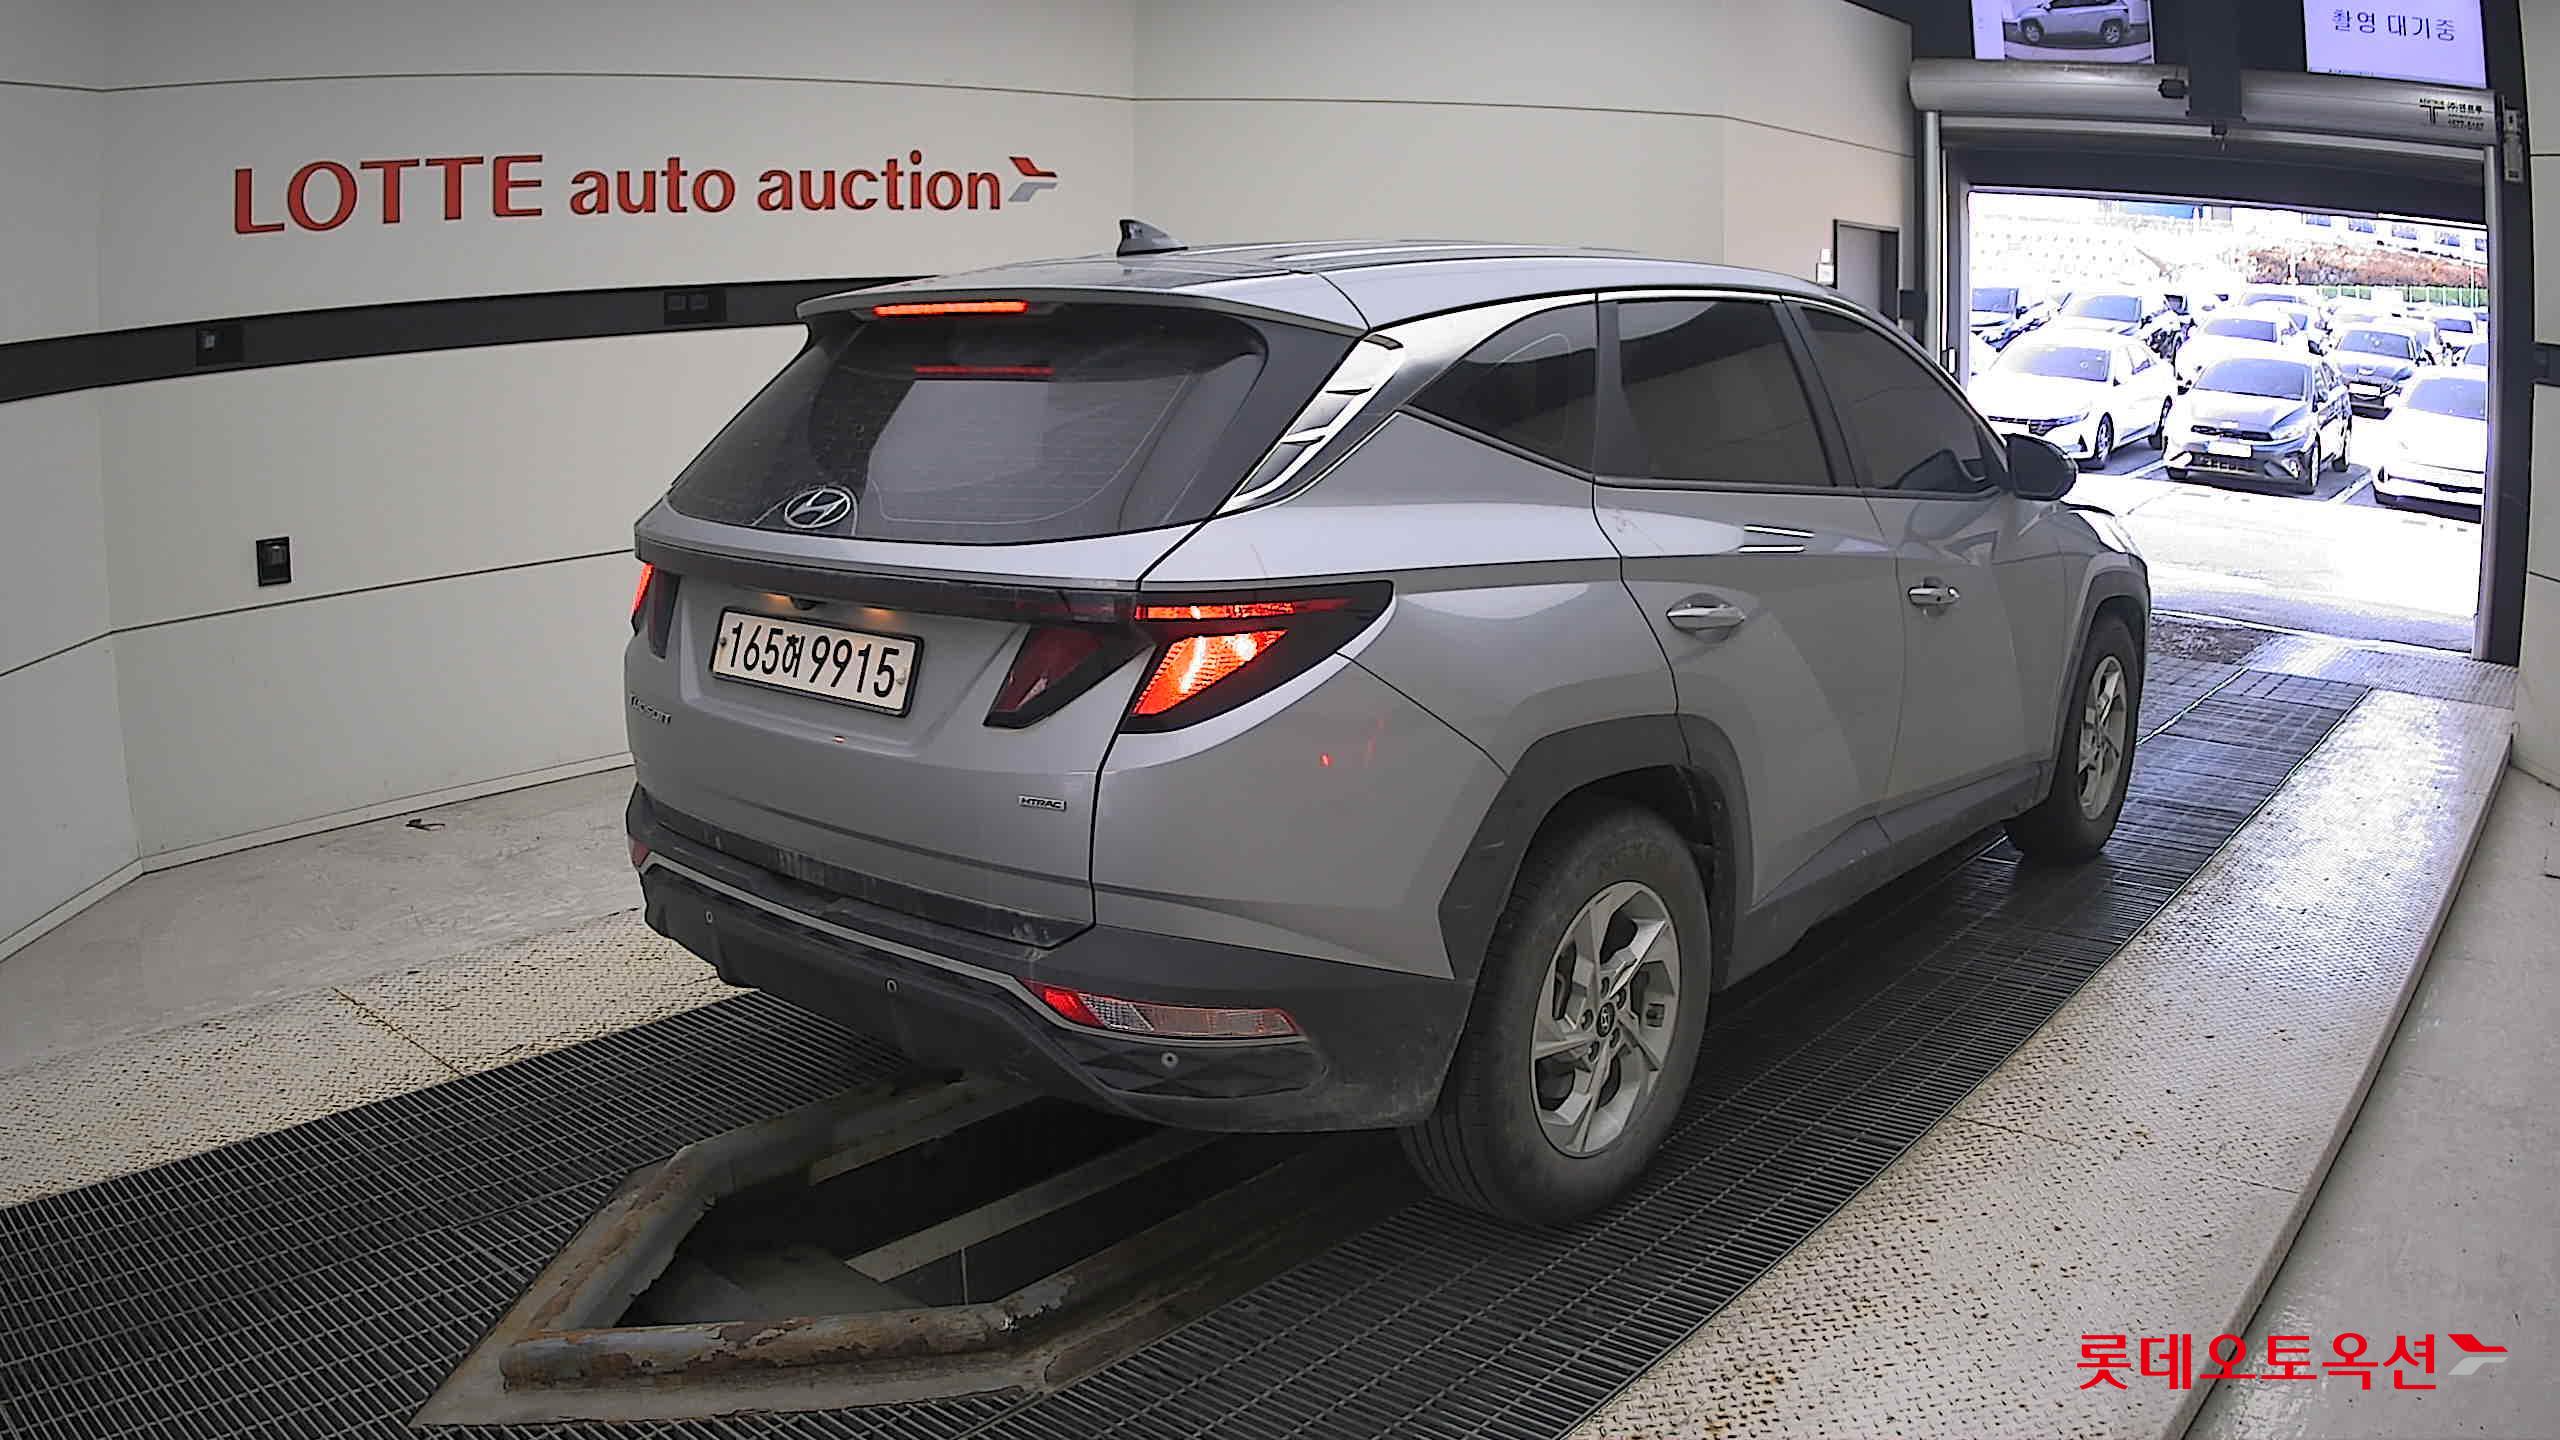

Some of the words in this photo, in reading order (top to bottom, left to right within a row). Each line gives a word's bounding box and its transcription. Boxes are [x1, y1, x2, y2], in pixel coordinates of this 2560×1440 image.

[2333, 9, 2376, 34] 촬영
[2387, 14, 2455, 42] 대기중
[236, 155, 541, 234] LOTTE
[569, 157, 737, 214] auto
[757, 150, 1002, 211] auction
[730, 621, 900, 698] 165허9915
